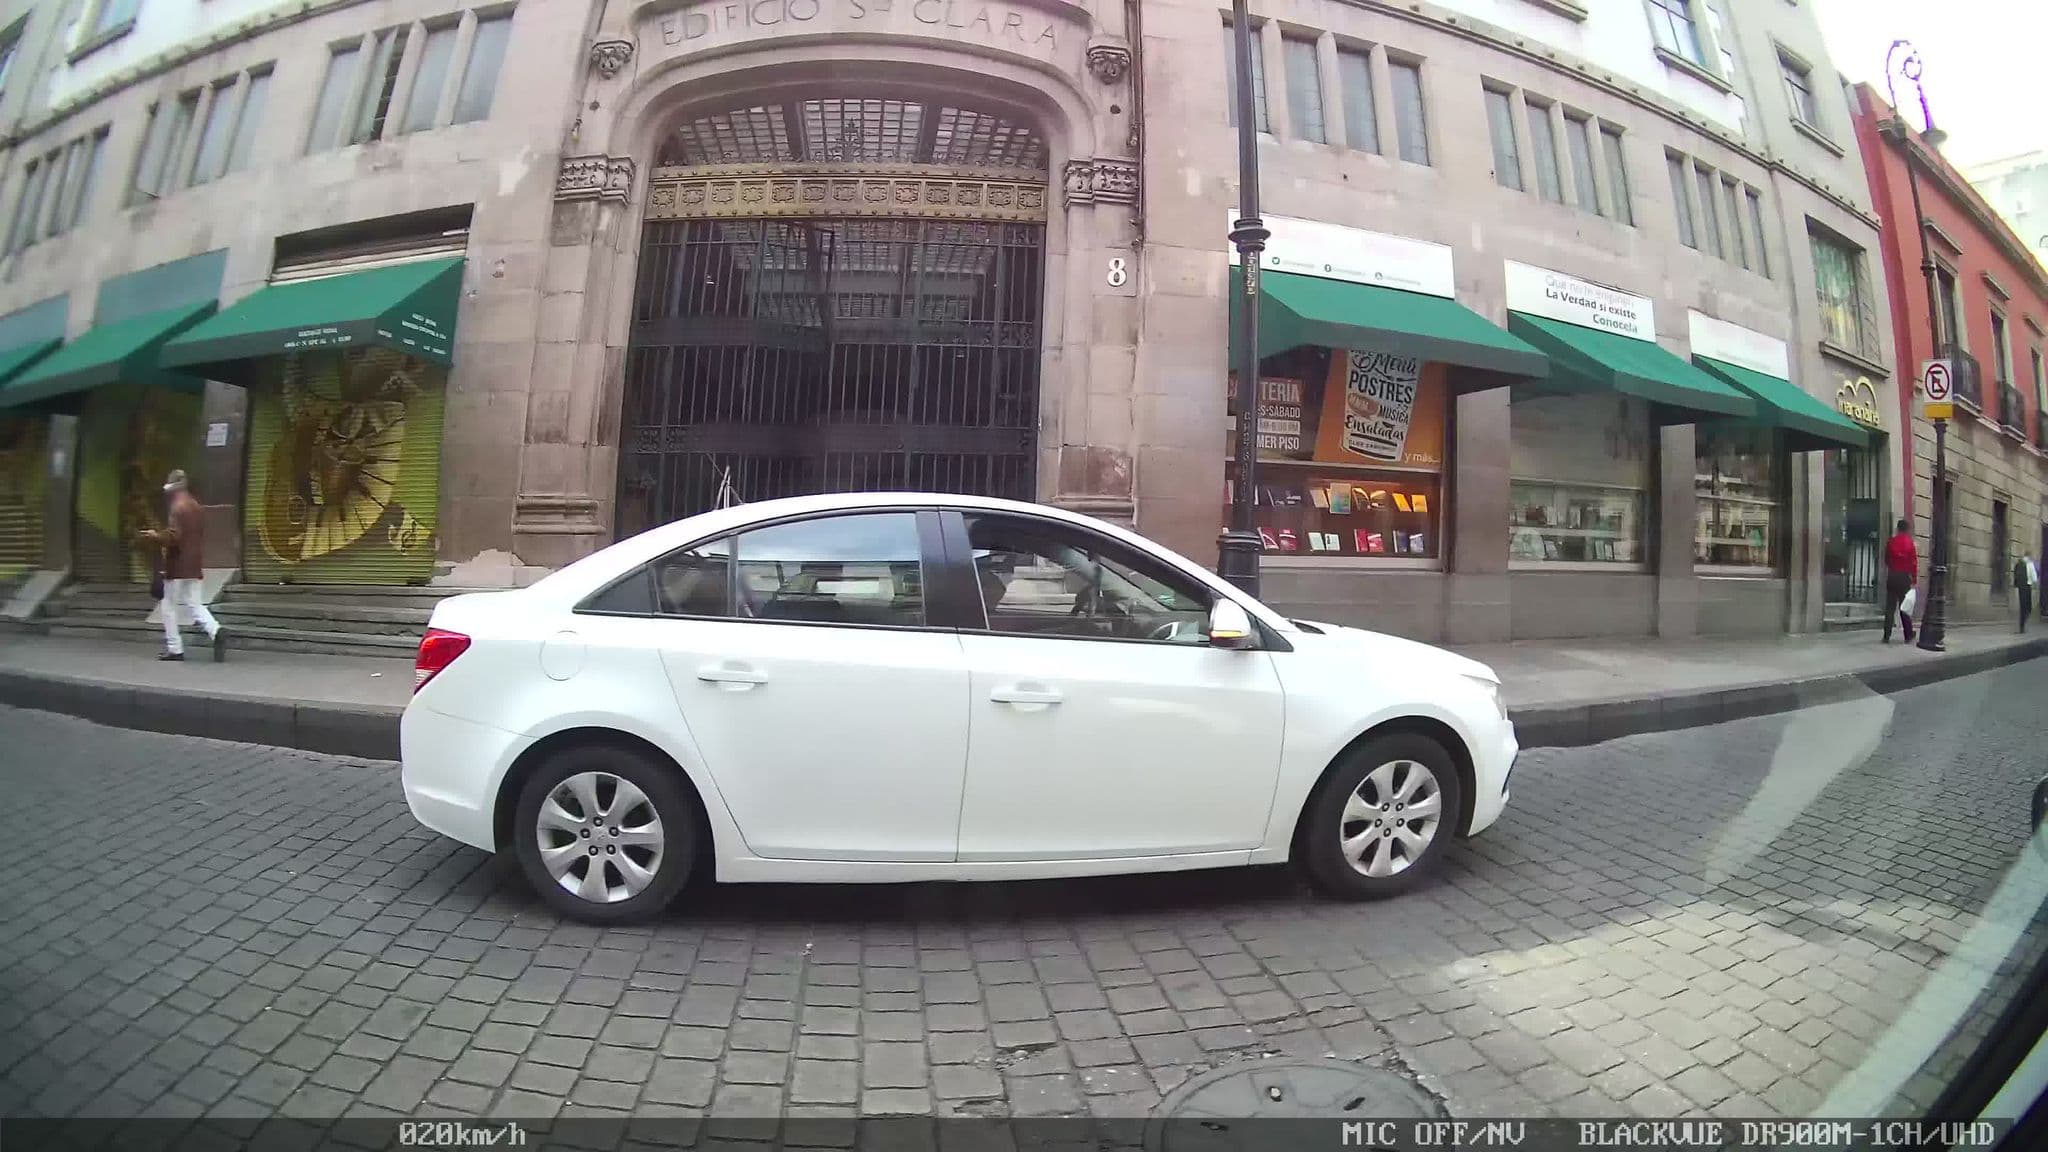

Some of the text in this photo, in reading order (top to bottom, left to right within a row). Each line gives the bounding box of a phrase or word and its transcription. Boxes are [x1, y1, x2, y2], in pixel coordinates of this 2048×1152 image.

[661, 0, 819, 45] EDIFICIO
[913, 0, 1057, 50] CLARA
[1107, 257, 1127, 287] 8
[1545, 287, 1559, 300] La
[1560, 292, 1597, 309] Verdad
[1608, 306, 1637, 320] existe
[1348, 370, 1413, 405] POSTRES
[1256, 434, 1300, 451] MER PISO
[1344, 414, 1404, 440] Ensaladas
